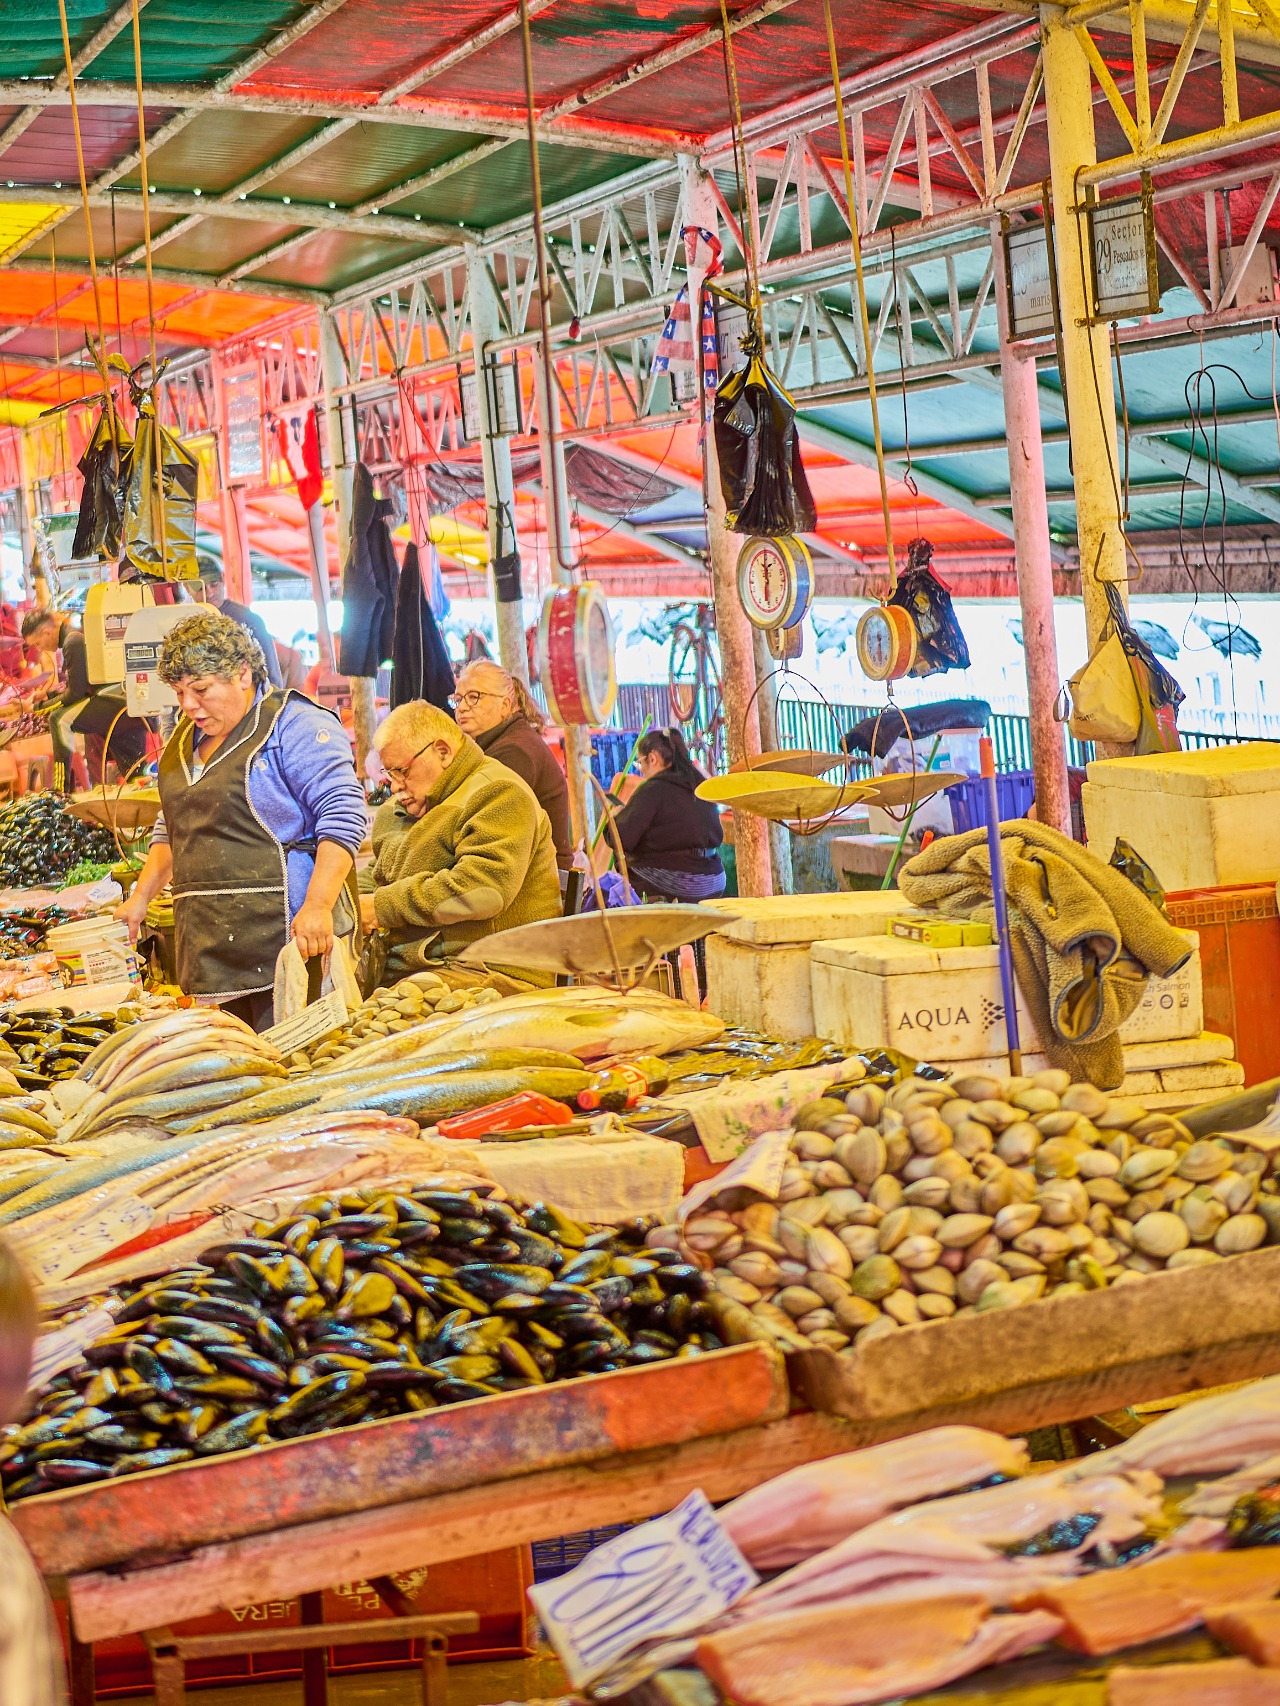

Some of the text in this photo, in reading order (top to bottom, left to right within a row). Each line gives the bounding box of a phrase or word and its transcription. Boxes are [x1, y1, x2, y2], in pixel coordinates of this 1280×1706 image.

[1111, 223, 1143, 241] Sector
[1096, 238, 1112, 275] 29
[1156, 981, 1191, 993] Salmon
[897, 1005, 971, 1032] AQUA
